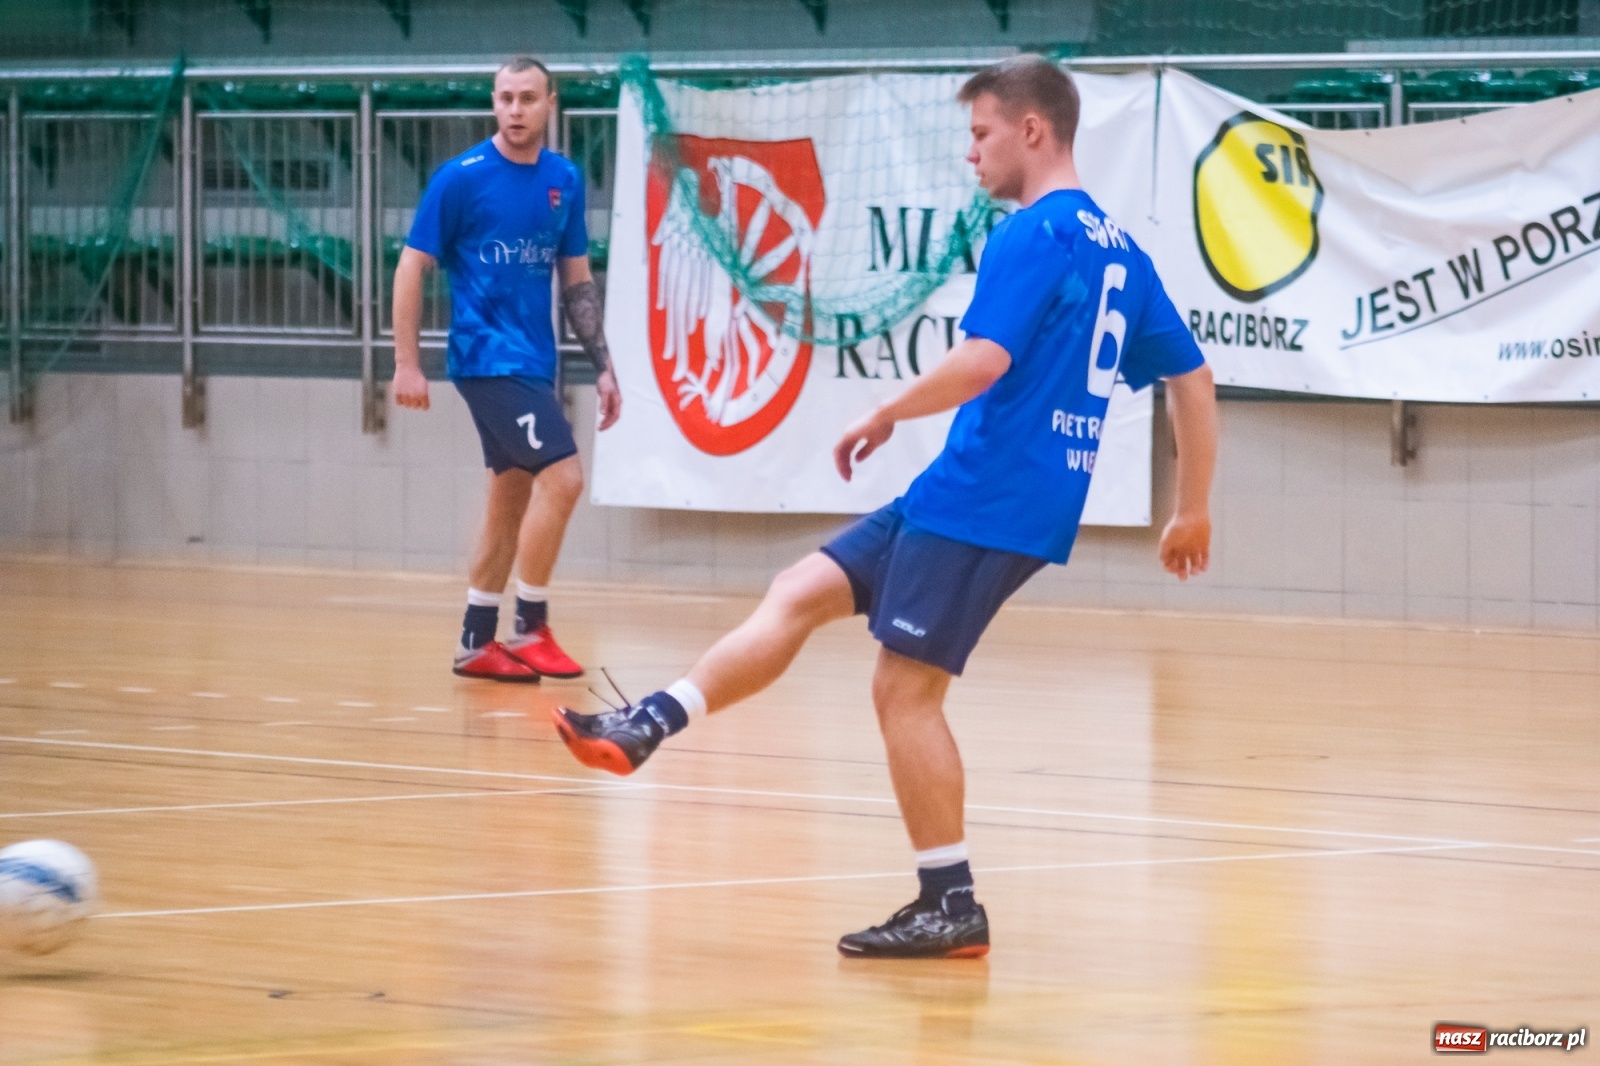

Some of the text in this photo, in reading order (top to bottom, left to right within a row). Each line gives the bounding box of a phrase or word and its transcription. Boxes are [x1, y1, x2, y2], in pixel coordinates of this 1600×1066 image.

[867, 206, 1007, 274] MIA
[1341, 268, 1437, 340] JEST
[1447, 248, 1484, 300] W
[1087, 263, 1127, 398] 6
[1189, 306, 1309, 352] RACIBÓRZ
[516, 413, 543, 449] 7
[1052, 409, 1104, 440] PIETR
